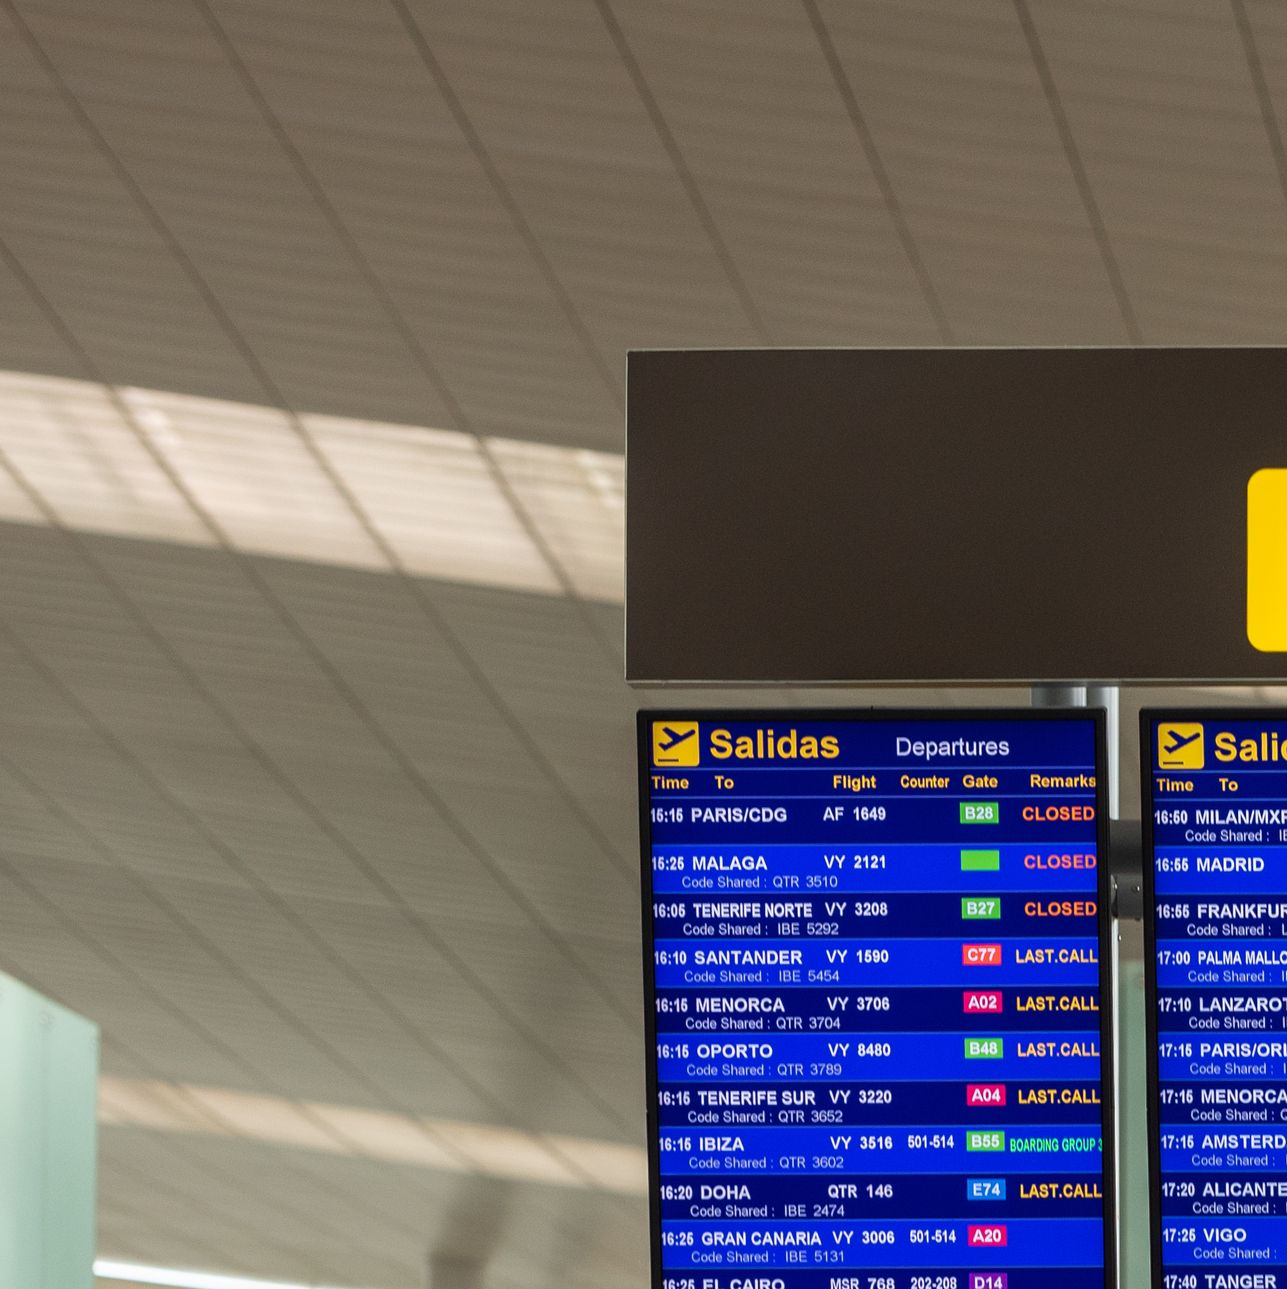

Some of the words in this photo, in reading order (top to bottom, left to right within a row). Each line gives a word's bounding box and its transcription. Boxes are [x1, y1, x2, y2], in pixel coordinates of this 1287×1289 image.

[710, 729, 839, 758] Salidas
[897, 738, 1009, 760] Departures
[652, 776, 689, 789] Time
[715, 776, 734, 789] To
[834, 775, 876, 791] Flight
[901, 775, 949, 788] Counter
[963, 775, 998, 788] Gate
[1030, 774, 1096, 787] Remarks
[1157, 779, 1193, 791] Time
[1219, 778, 1238, 791] To
[692, 808, 787, 822] PARIS/CDG
[823, 807, 844, 821] AF
[854, 807, 886, 820] 1649
[966, 807, 993, 819] B28
[1022, 806, 1095, 821] CLOSED
[682, 876, 713, 888] Code
[718, 876, 759, 888] Shared
[773, 876, 799, 888] QTR
[807, 876, 837, 887] 3510
[1163, 1228, 1196, 1242] 17:25
[1204, 1228, 1246, 1242] VIGO
